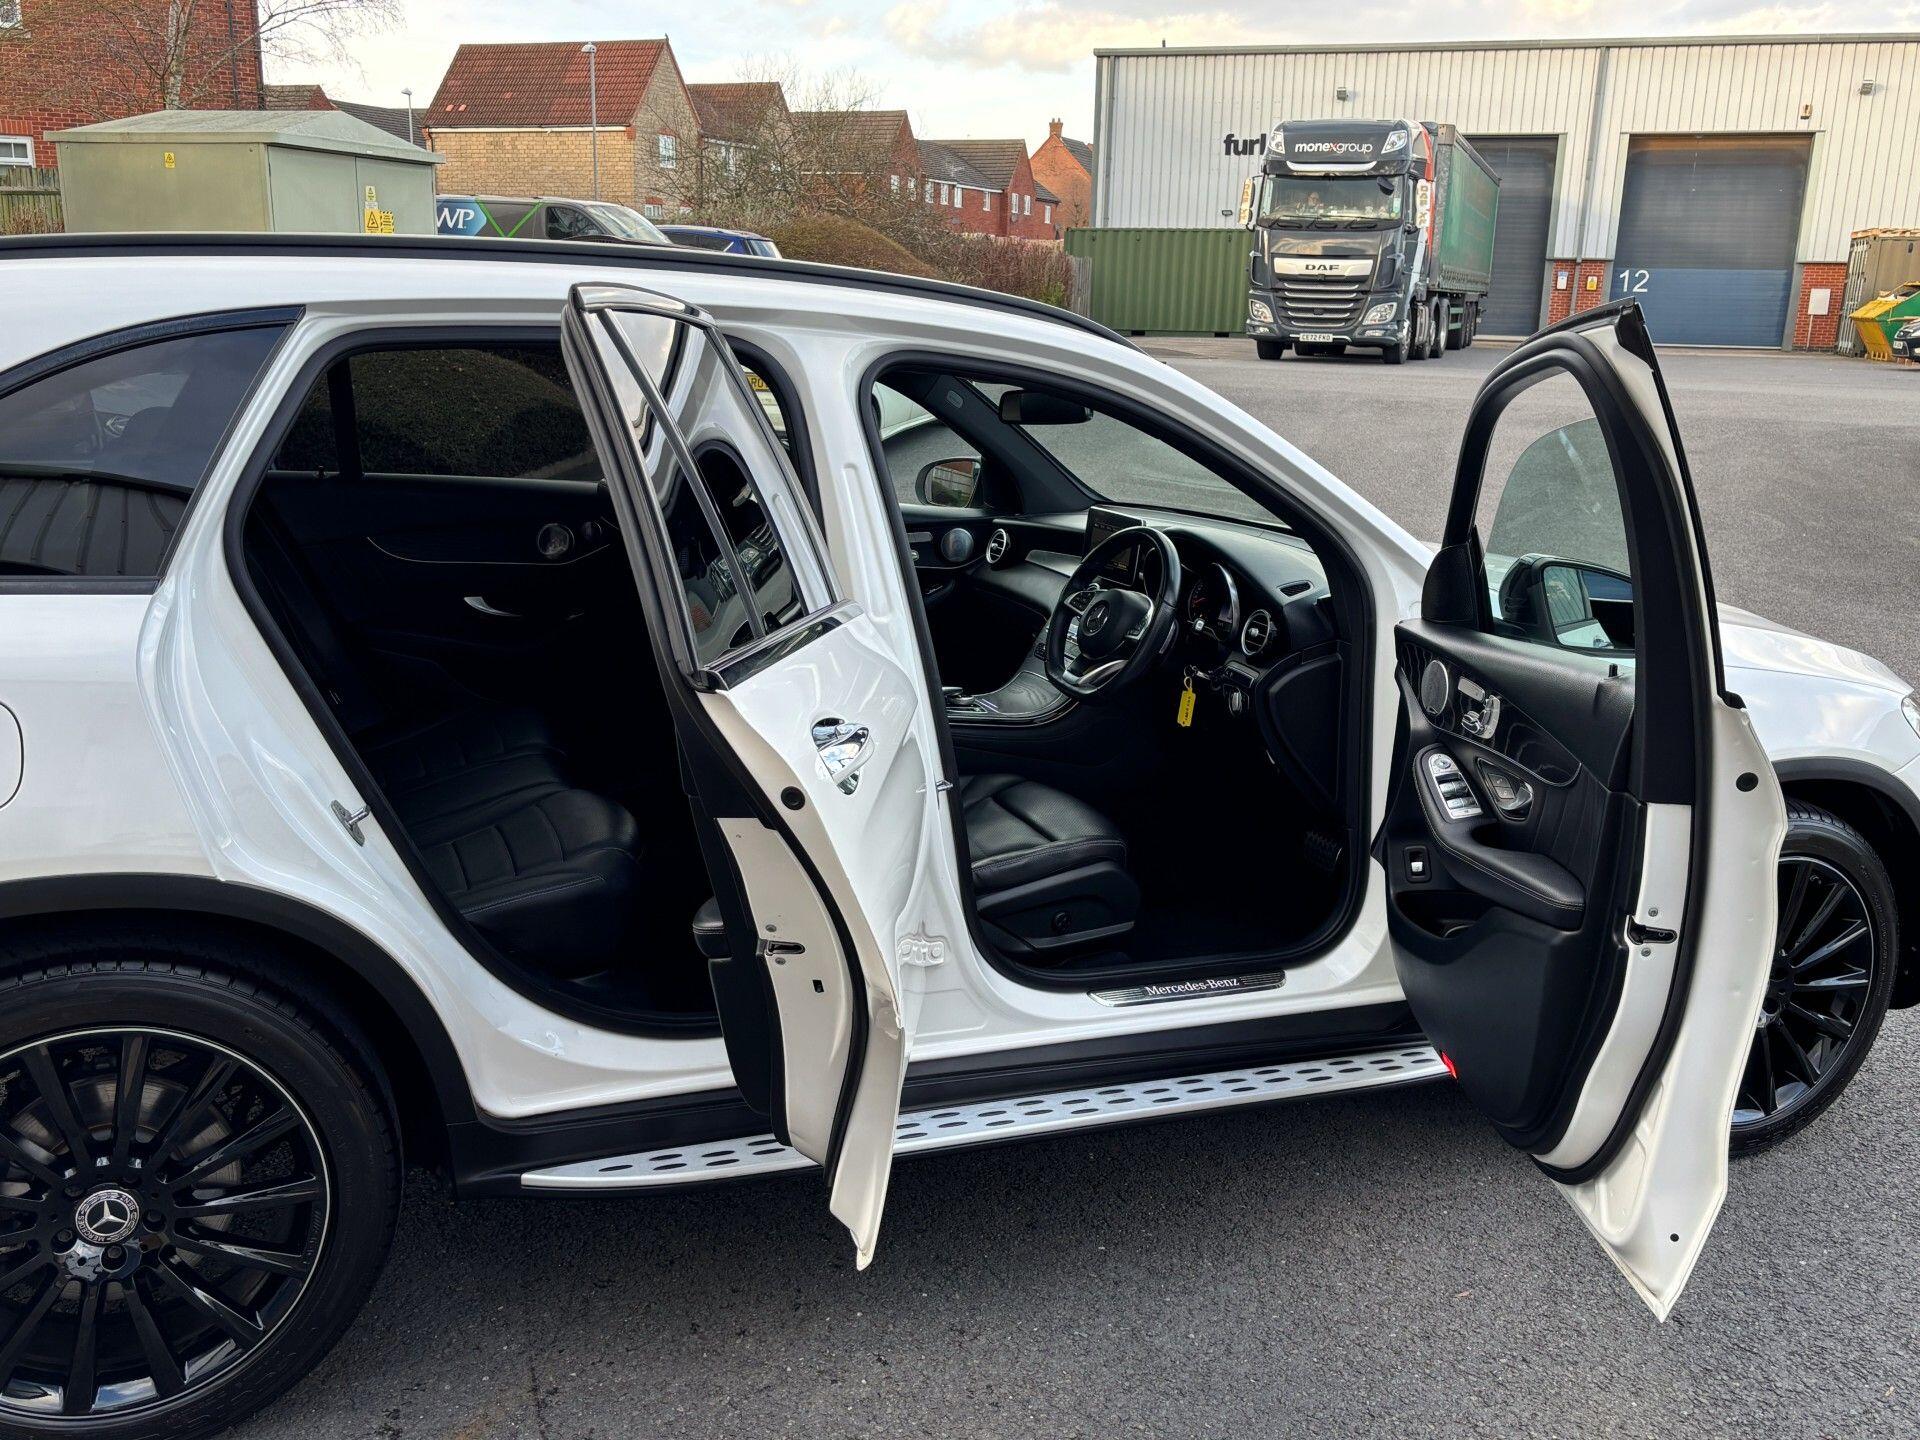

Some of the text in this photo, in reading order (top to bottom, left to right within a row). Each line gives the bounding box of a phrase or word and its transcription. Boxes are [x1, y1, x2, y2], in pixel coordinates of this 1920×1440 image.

[1294, 142, 1373, 154] monexgroup
[1619, 269, 1650, 293] 12
[1145, 978, 1239, 996] Mercedes-Benz
